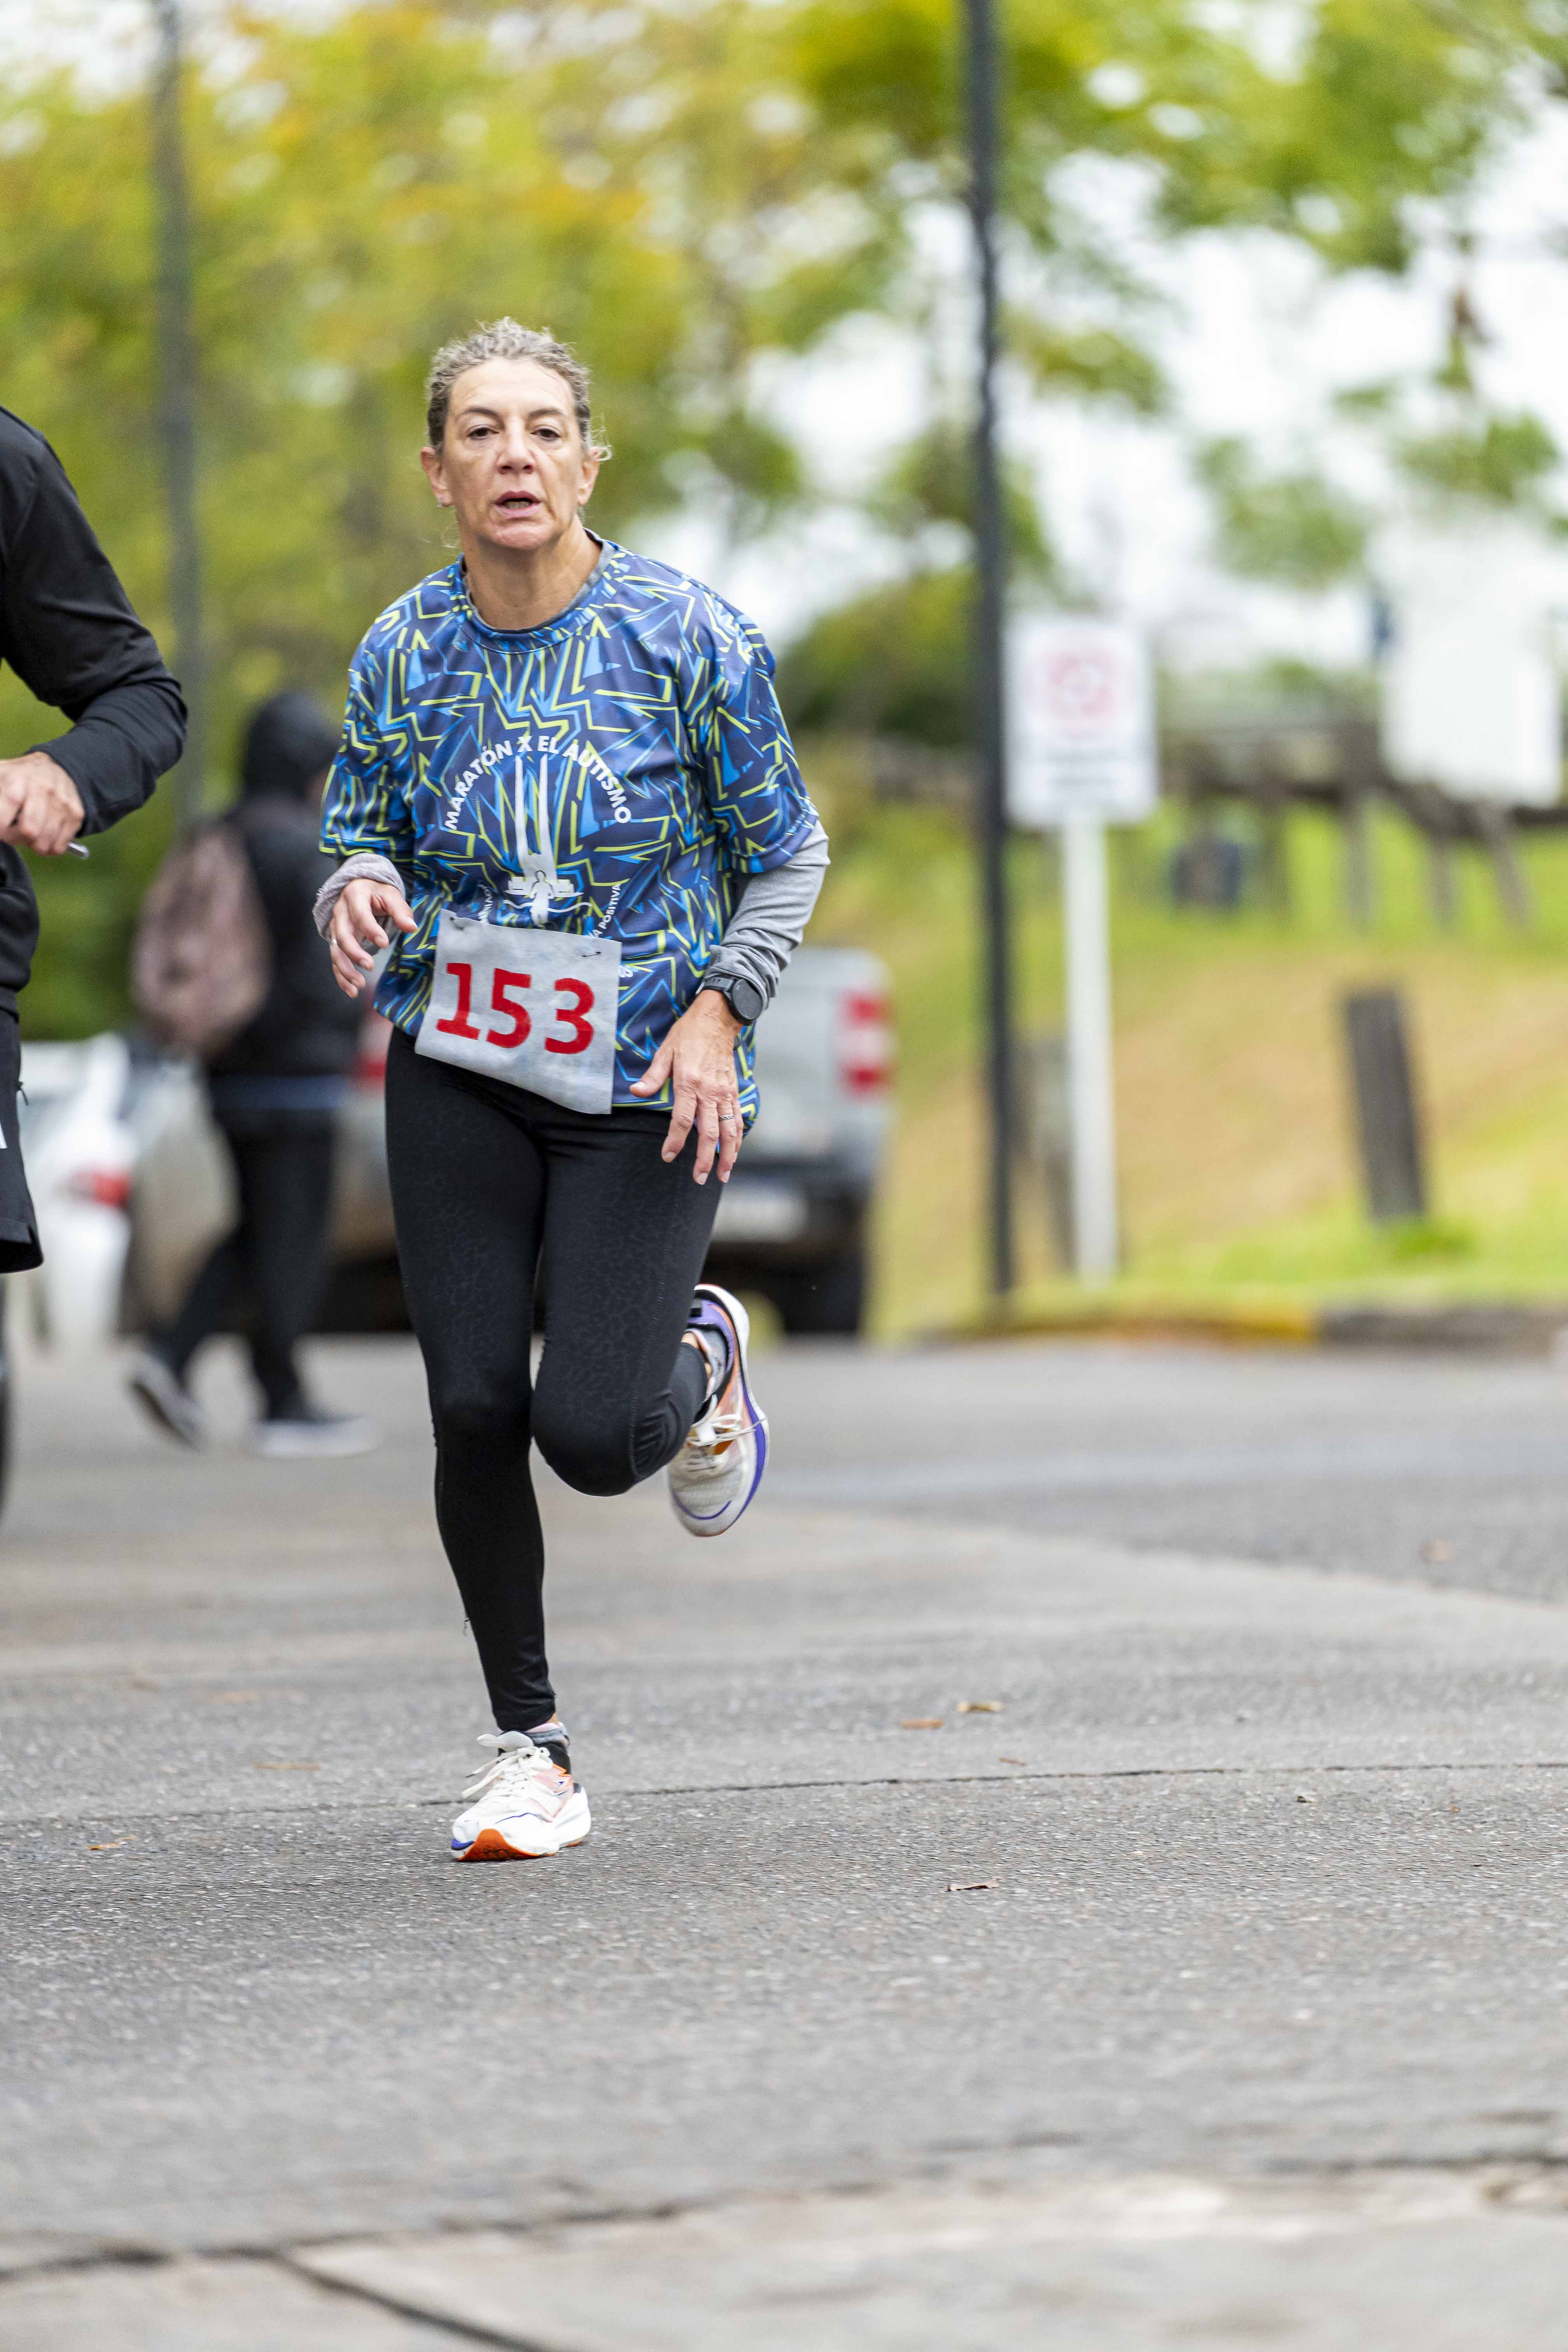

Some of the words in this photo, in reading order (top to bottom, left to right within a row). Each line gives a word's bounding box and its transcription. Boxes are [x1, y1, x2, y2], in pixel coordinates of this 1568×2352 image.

[444, 740, 513, 830] MARATÓN
[517, 735, 533, 753] X
[537, 735, 560, 754] EL
[562, 741, 632, 824] AUTISMO
[597, 883, 621, 929] POSITIVA
[436, 962, 595, 1055] 153
